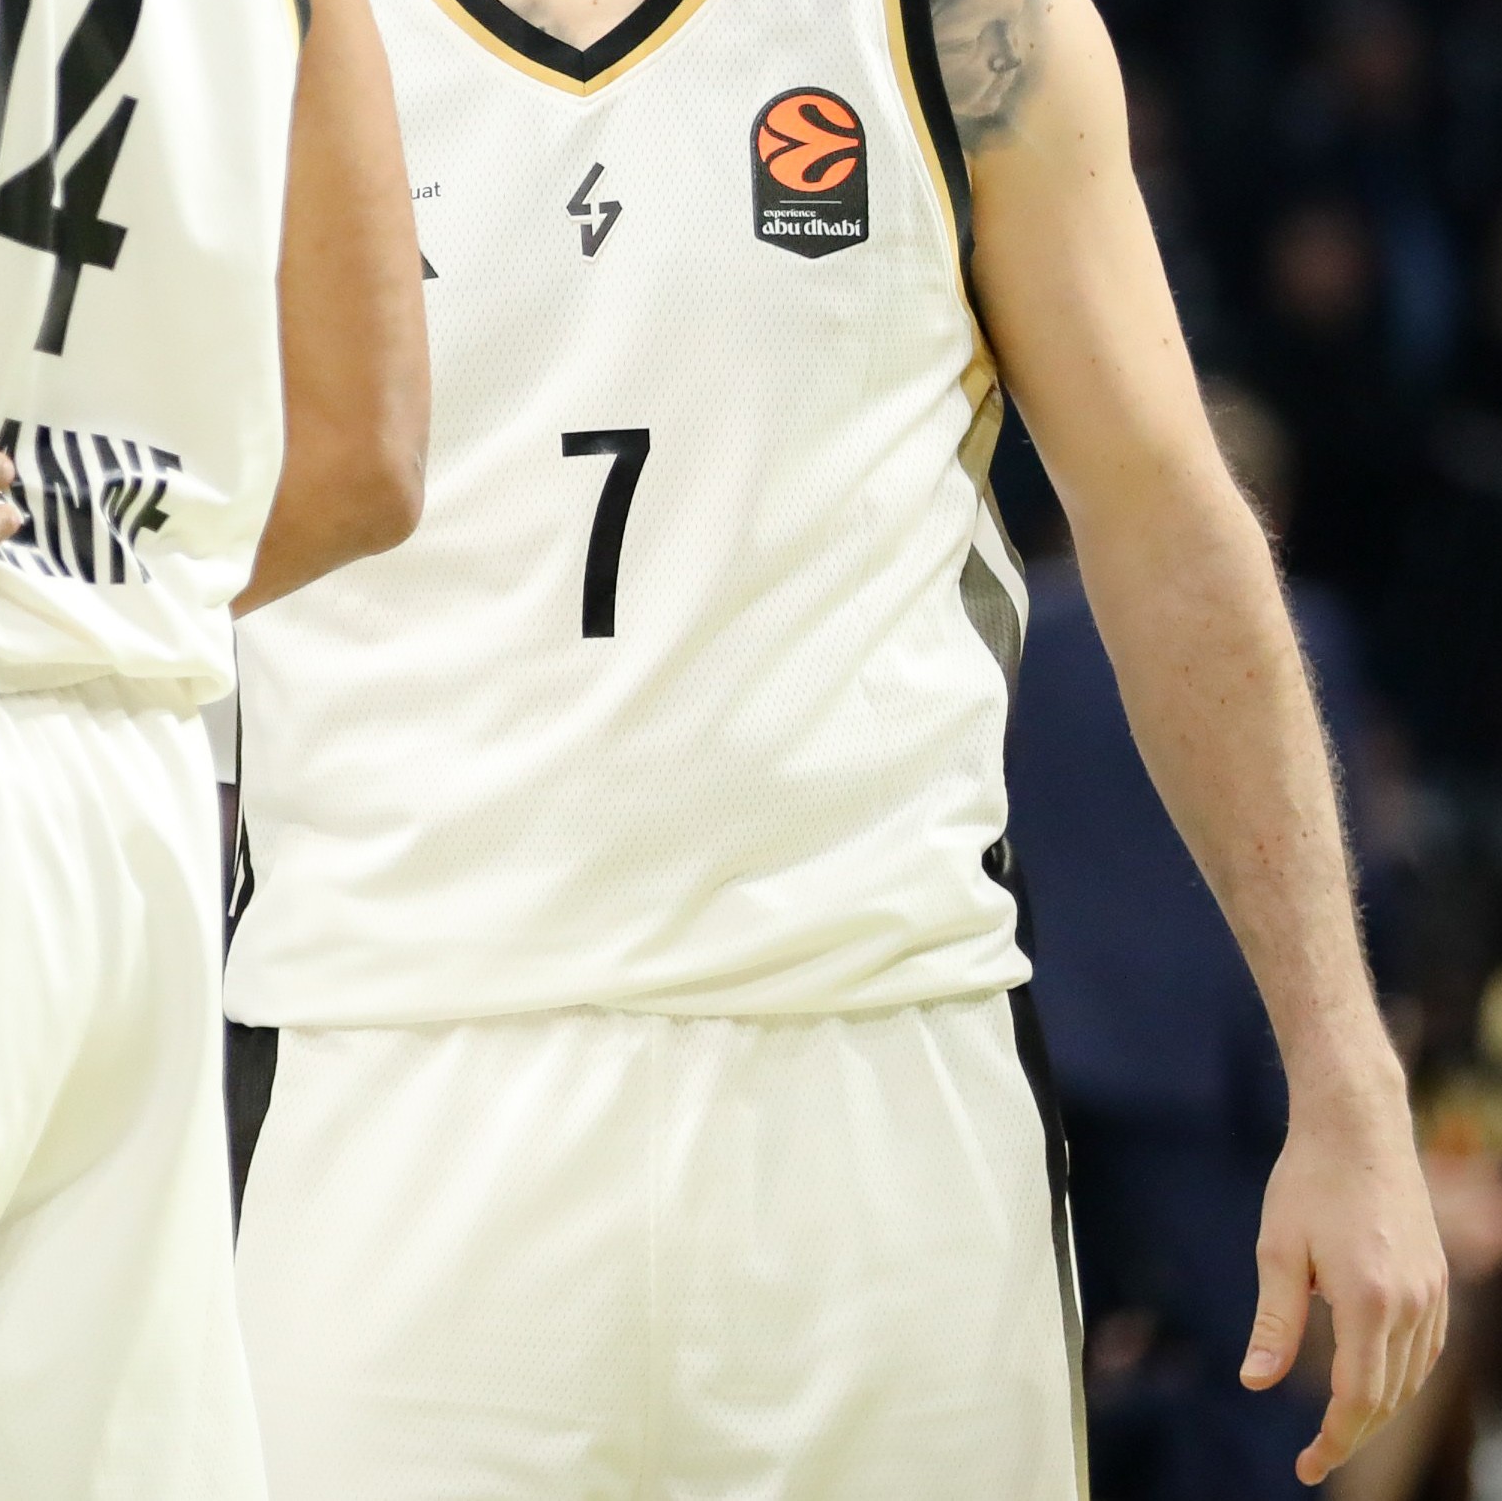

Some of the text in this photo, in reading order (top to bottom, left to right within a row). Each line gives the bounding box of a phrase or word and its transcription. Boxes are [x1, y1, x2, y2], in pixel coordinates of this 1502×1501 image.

[763, 209, 817, 219] experience
[762, 218, 801, 236] abu
[561, 428, 651, 639] 7
